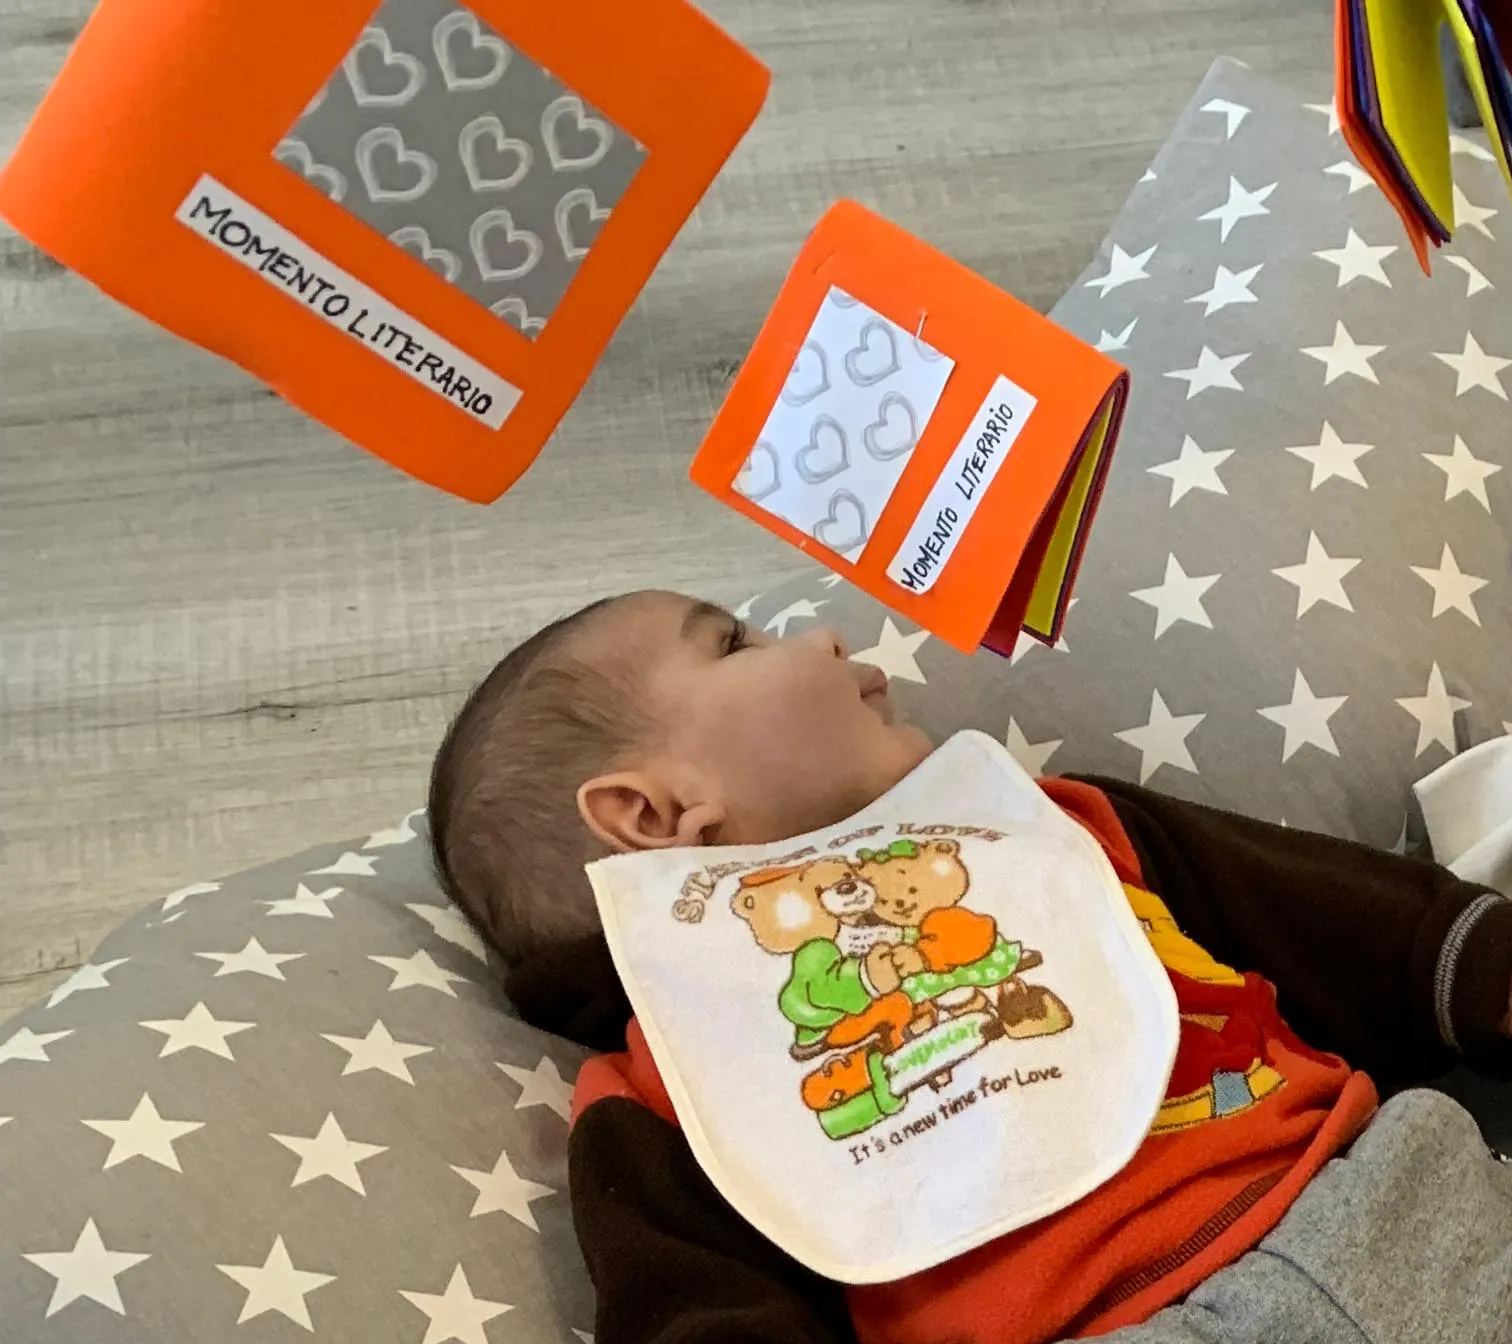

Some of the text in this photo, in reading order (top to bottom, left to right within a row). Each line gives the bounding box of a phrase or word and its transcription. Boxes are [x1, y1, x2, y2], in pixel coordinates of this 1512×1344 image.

[190, 196, 492, 415] MOMENTO LITERARIO
[901, 403, 1013, 589] MOMENTO LITERARIO
[849, 1065, 1062, 1165] It's a new time for Love
